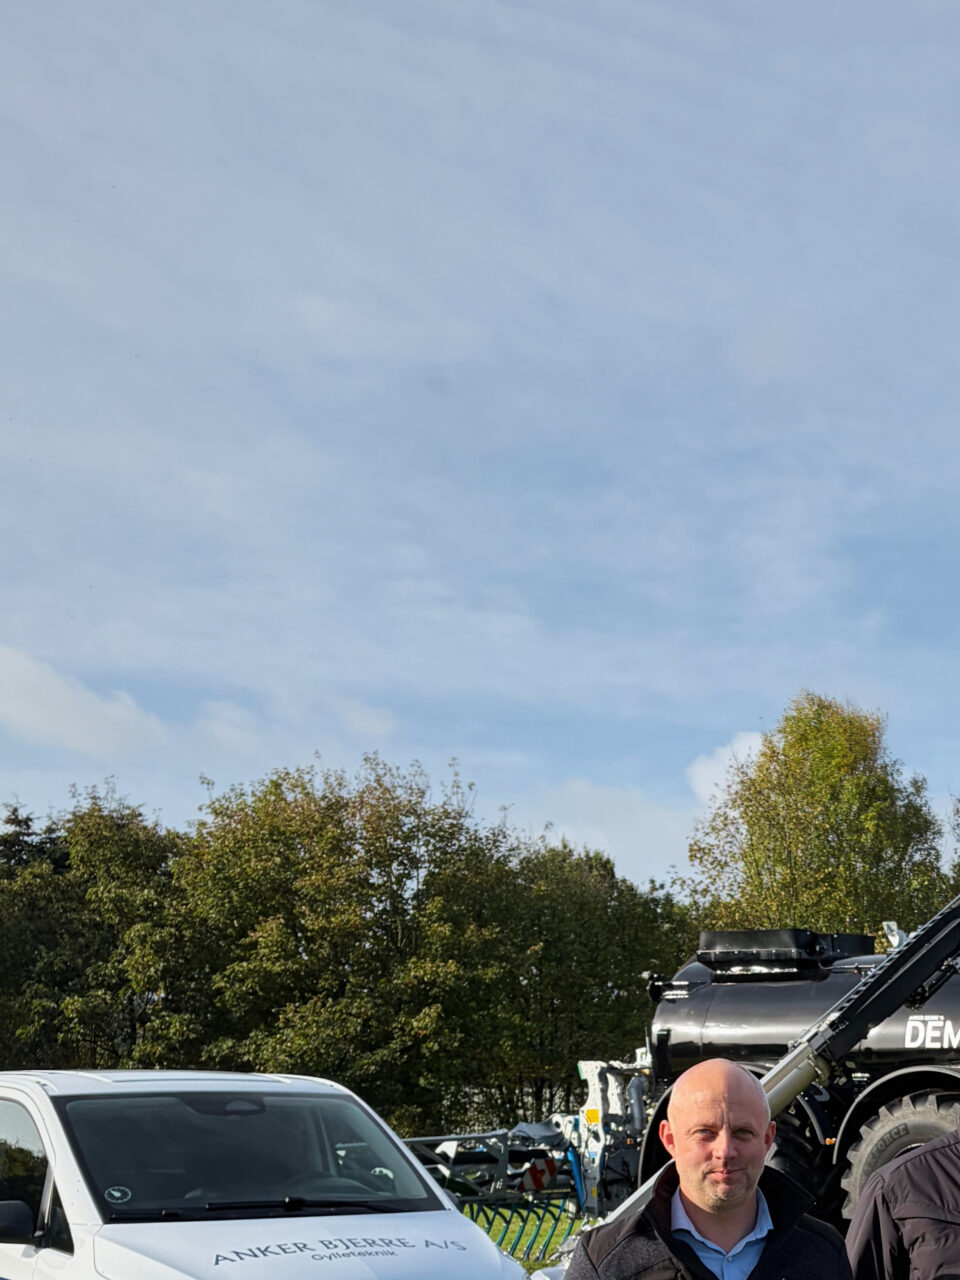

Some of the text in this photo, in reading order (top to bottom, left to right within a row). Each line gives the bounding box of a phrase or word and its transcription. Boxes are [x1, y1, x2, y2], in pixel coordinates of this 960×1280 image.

[213, 1237, 467, 1266] ANKER BJERRE A/S
[311, 1249, 399, 1262] Gylleteknik
